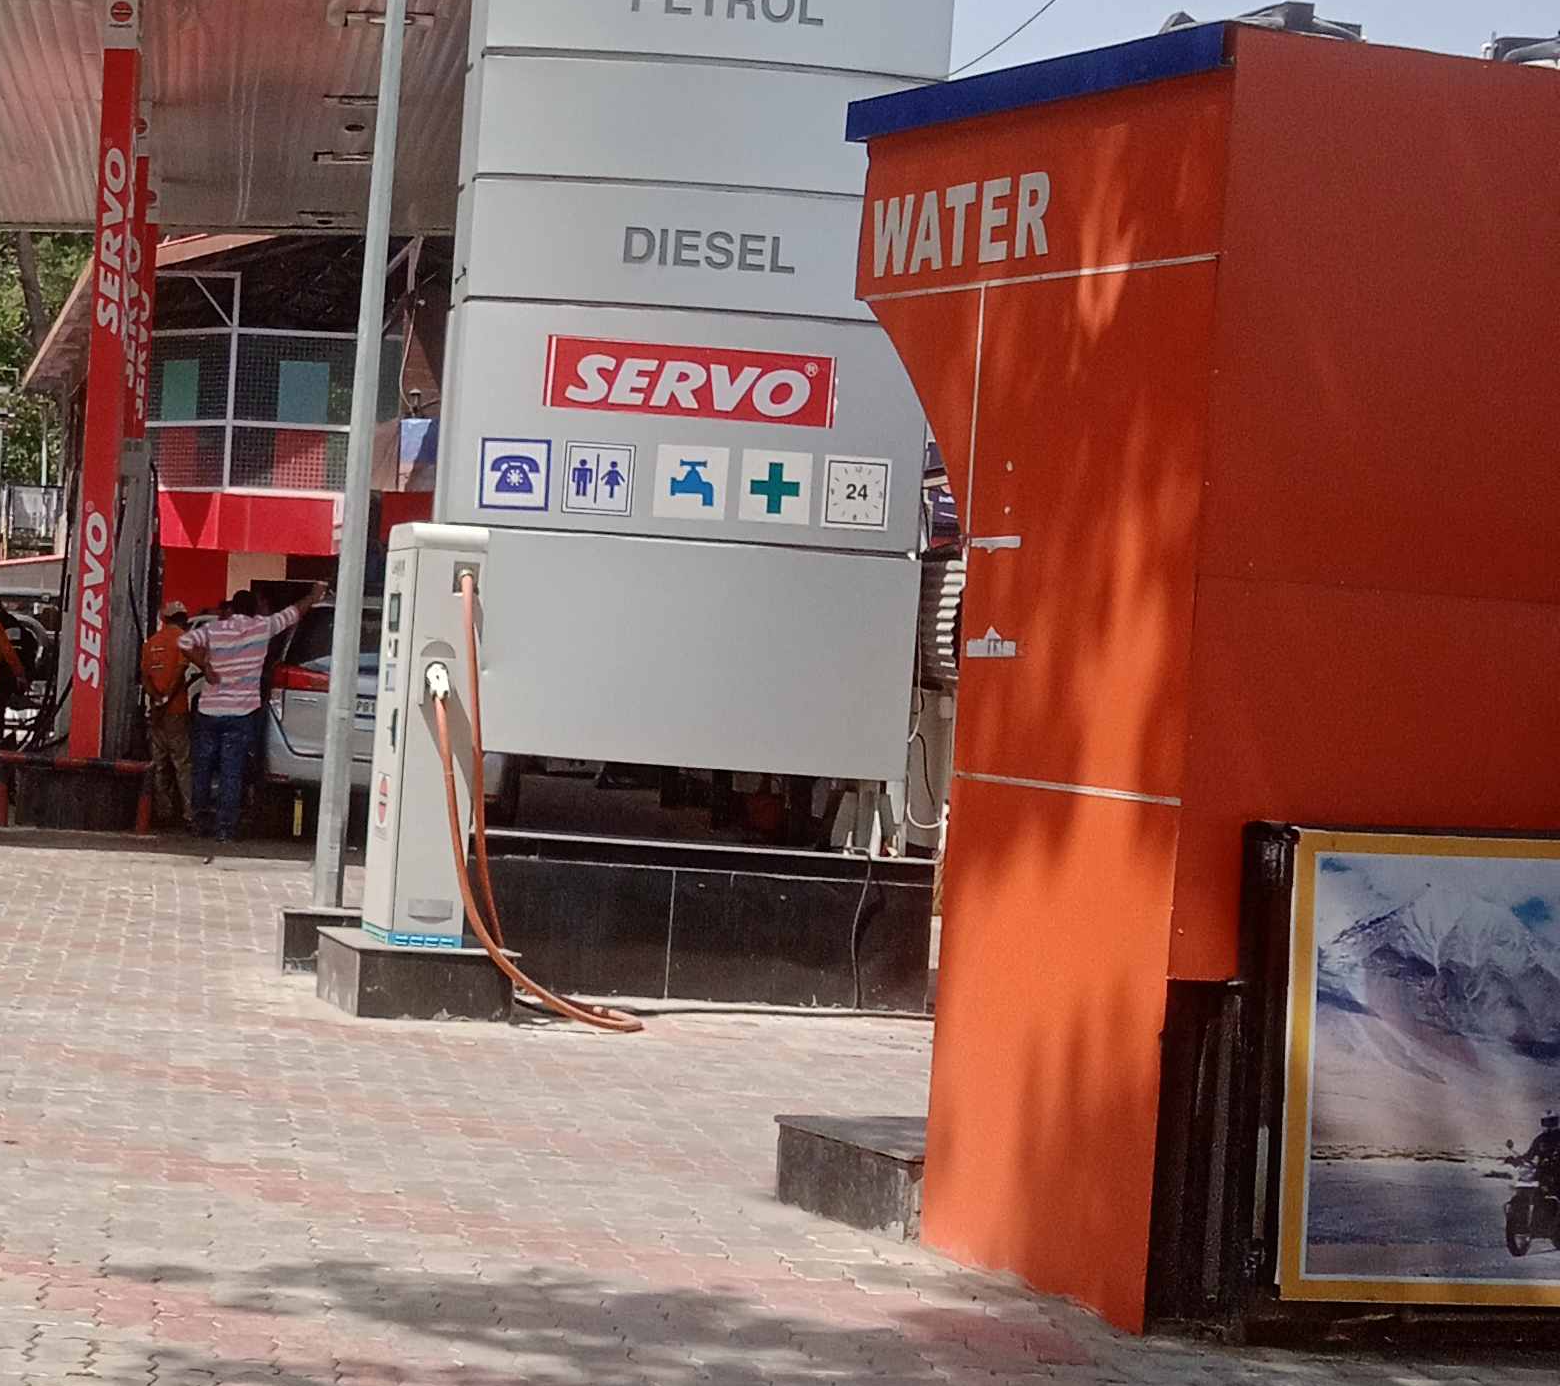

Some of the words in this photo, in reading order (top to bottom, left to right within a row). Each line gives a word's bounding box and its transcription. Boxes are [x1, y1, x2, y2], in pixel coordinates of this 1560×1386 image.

[96, 145, 127, 336] SERVO
[621, 226, 796, 274] DIESEL
[872, 170, 1052, 277] WATER
[564, 353, 812, 417] SERVO
[845, 482, 869, 502] 24
[77, 511, 108, 689] SERVO
